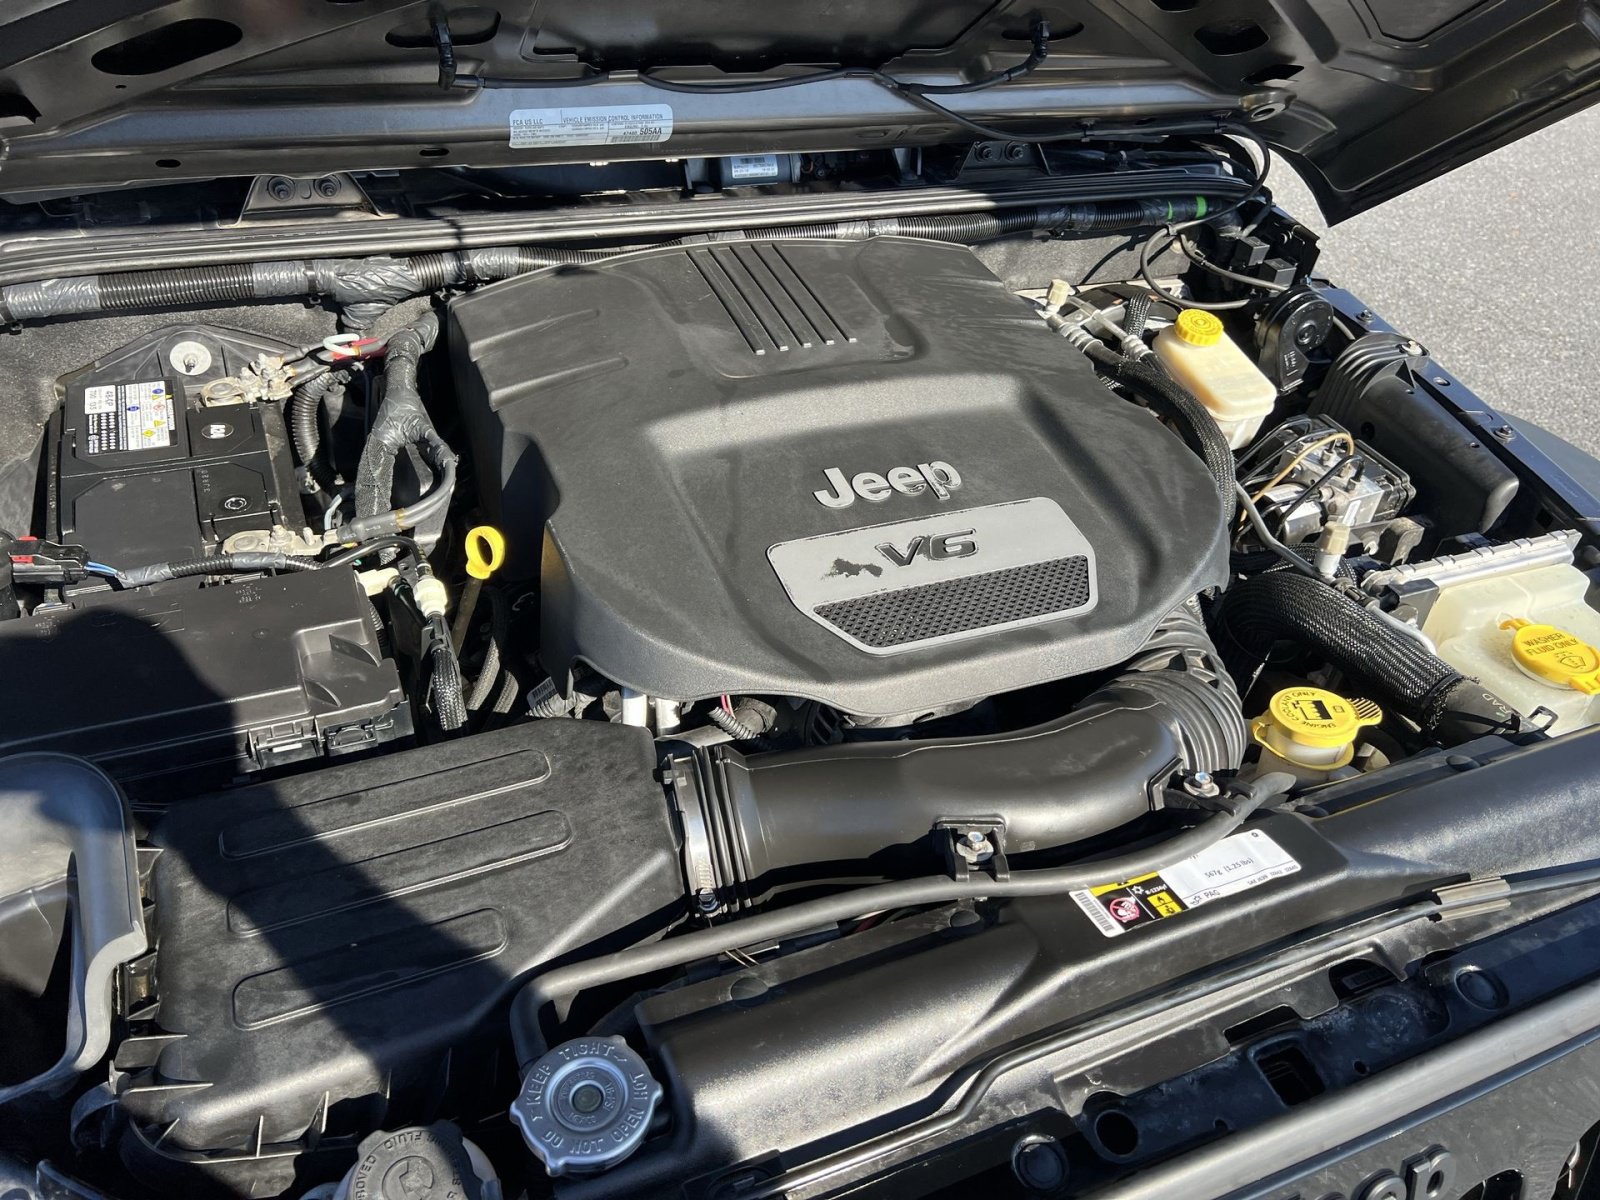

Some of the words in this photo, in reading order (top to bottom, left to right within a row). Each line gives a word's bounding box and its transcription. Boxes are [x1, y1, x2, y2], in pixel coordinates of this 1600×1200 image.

[812, 460, 962, 509] Jeep
[874, 527, 978, 567] V6
[1523, 632, 1566, 647] WASHER
[1525, 644, 1555, 656] FLUID
[1553, 637, 1579, 650] ONLY
[1204, 869, 1223, 878] 567g
[1203, 889, 1221, 899] PAG
[526, 1064, 551, 1106] KEEP
[558, 1043, 615, 1061] TIGHT
[543, 1131, 564, 1149] DO
[569, 1138, 604, 1155] NOT
[610, 1107, 645, 1143] OPEN
[630, 1072, 648, 1101] HOT
[383, 1131, 422, 1150] FLUID
